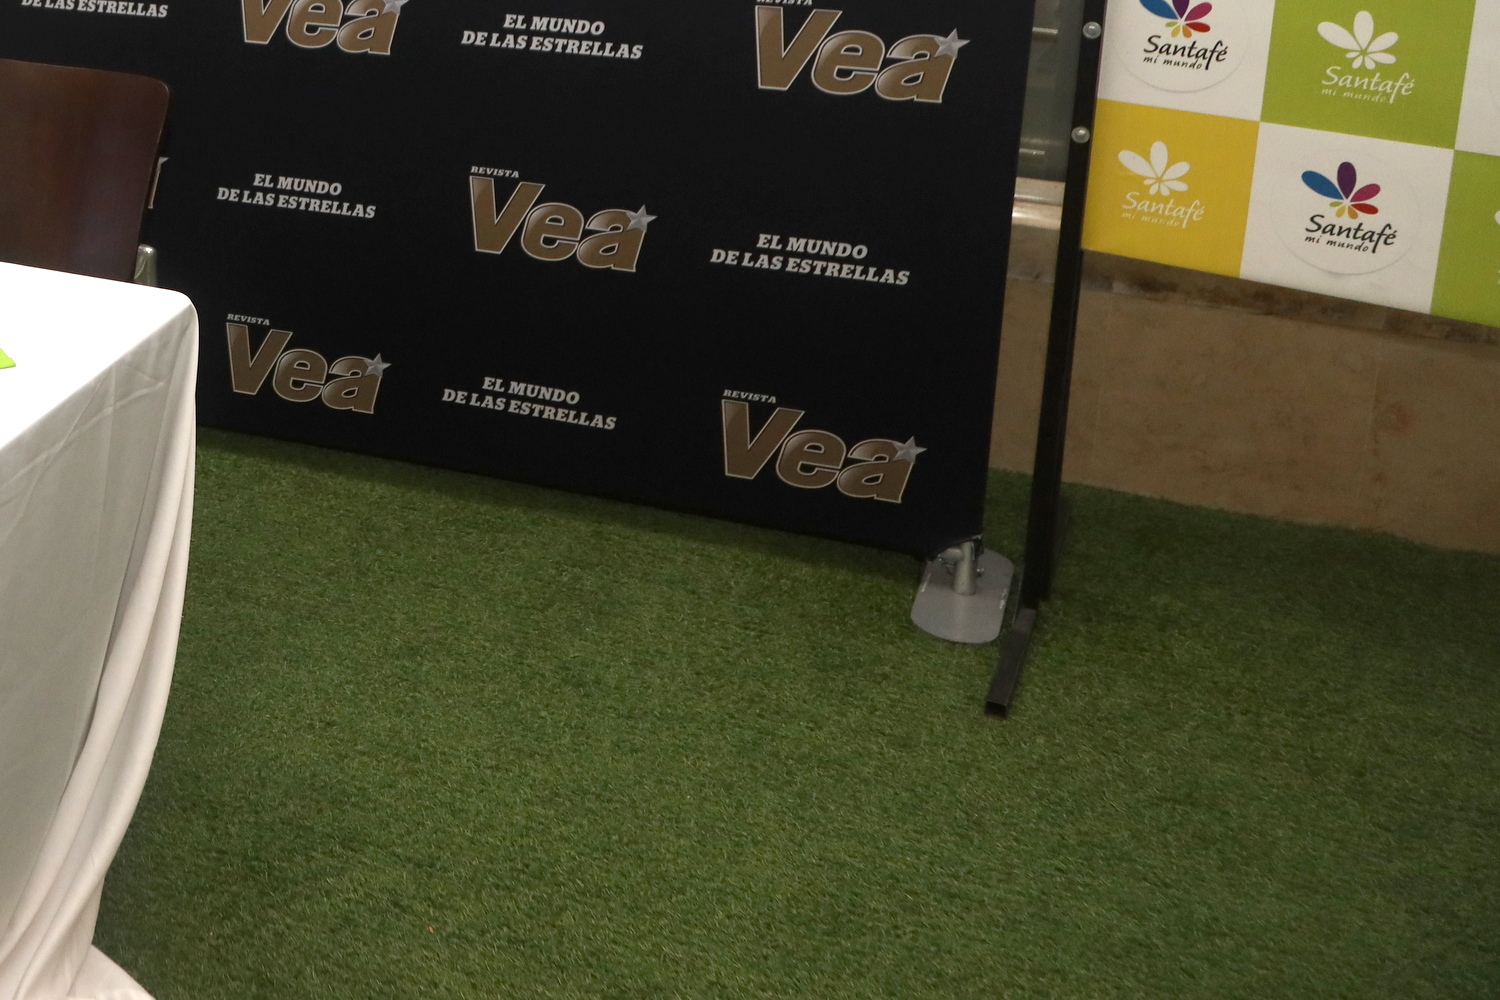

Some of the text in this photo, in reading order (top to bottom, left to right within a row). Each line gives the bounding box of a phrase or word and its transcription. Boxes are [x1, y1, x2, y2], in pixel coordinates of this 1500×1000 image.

[503, 13, 604, 35] EL MUNDO
[461, 30, 643, 59] DE LAS ESTRELLAS
[754, 4, 958, 104] Vea
[1143, 34, 1228, 70] Santafé
[1143, 54, 1203, 70] mi mundo
[1321, 66, 1414, 104] Santafé
[470, 165, 518, 178] REVISTA
[468, 175, 648, 273] Vea
[1122, 192, 1204, 228] Santafé
[1305, 214, 1397, 254] Santafé
[1305, 234, 1369, 253] mi mundo
[227, 313, 269, 325] REVISTA
[225, 321, 383, 415] Vea
[482, 376, 579, 404] EL MUNDO
[723, 389, 775, 403] REVISTA
[442, 388, 616, 429] DE LAS ESTRELLAS
[721, 398, 916, 504] Vea
